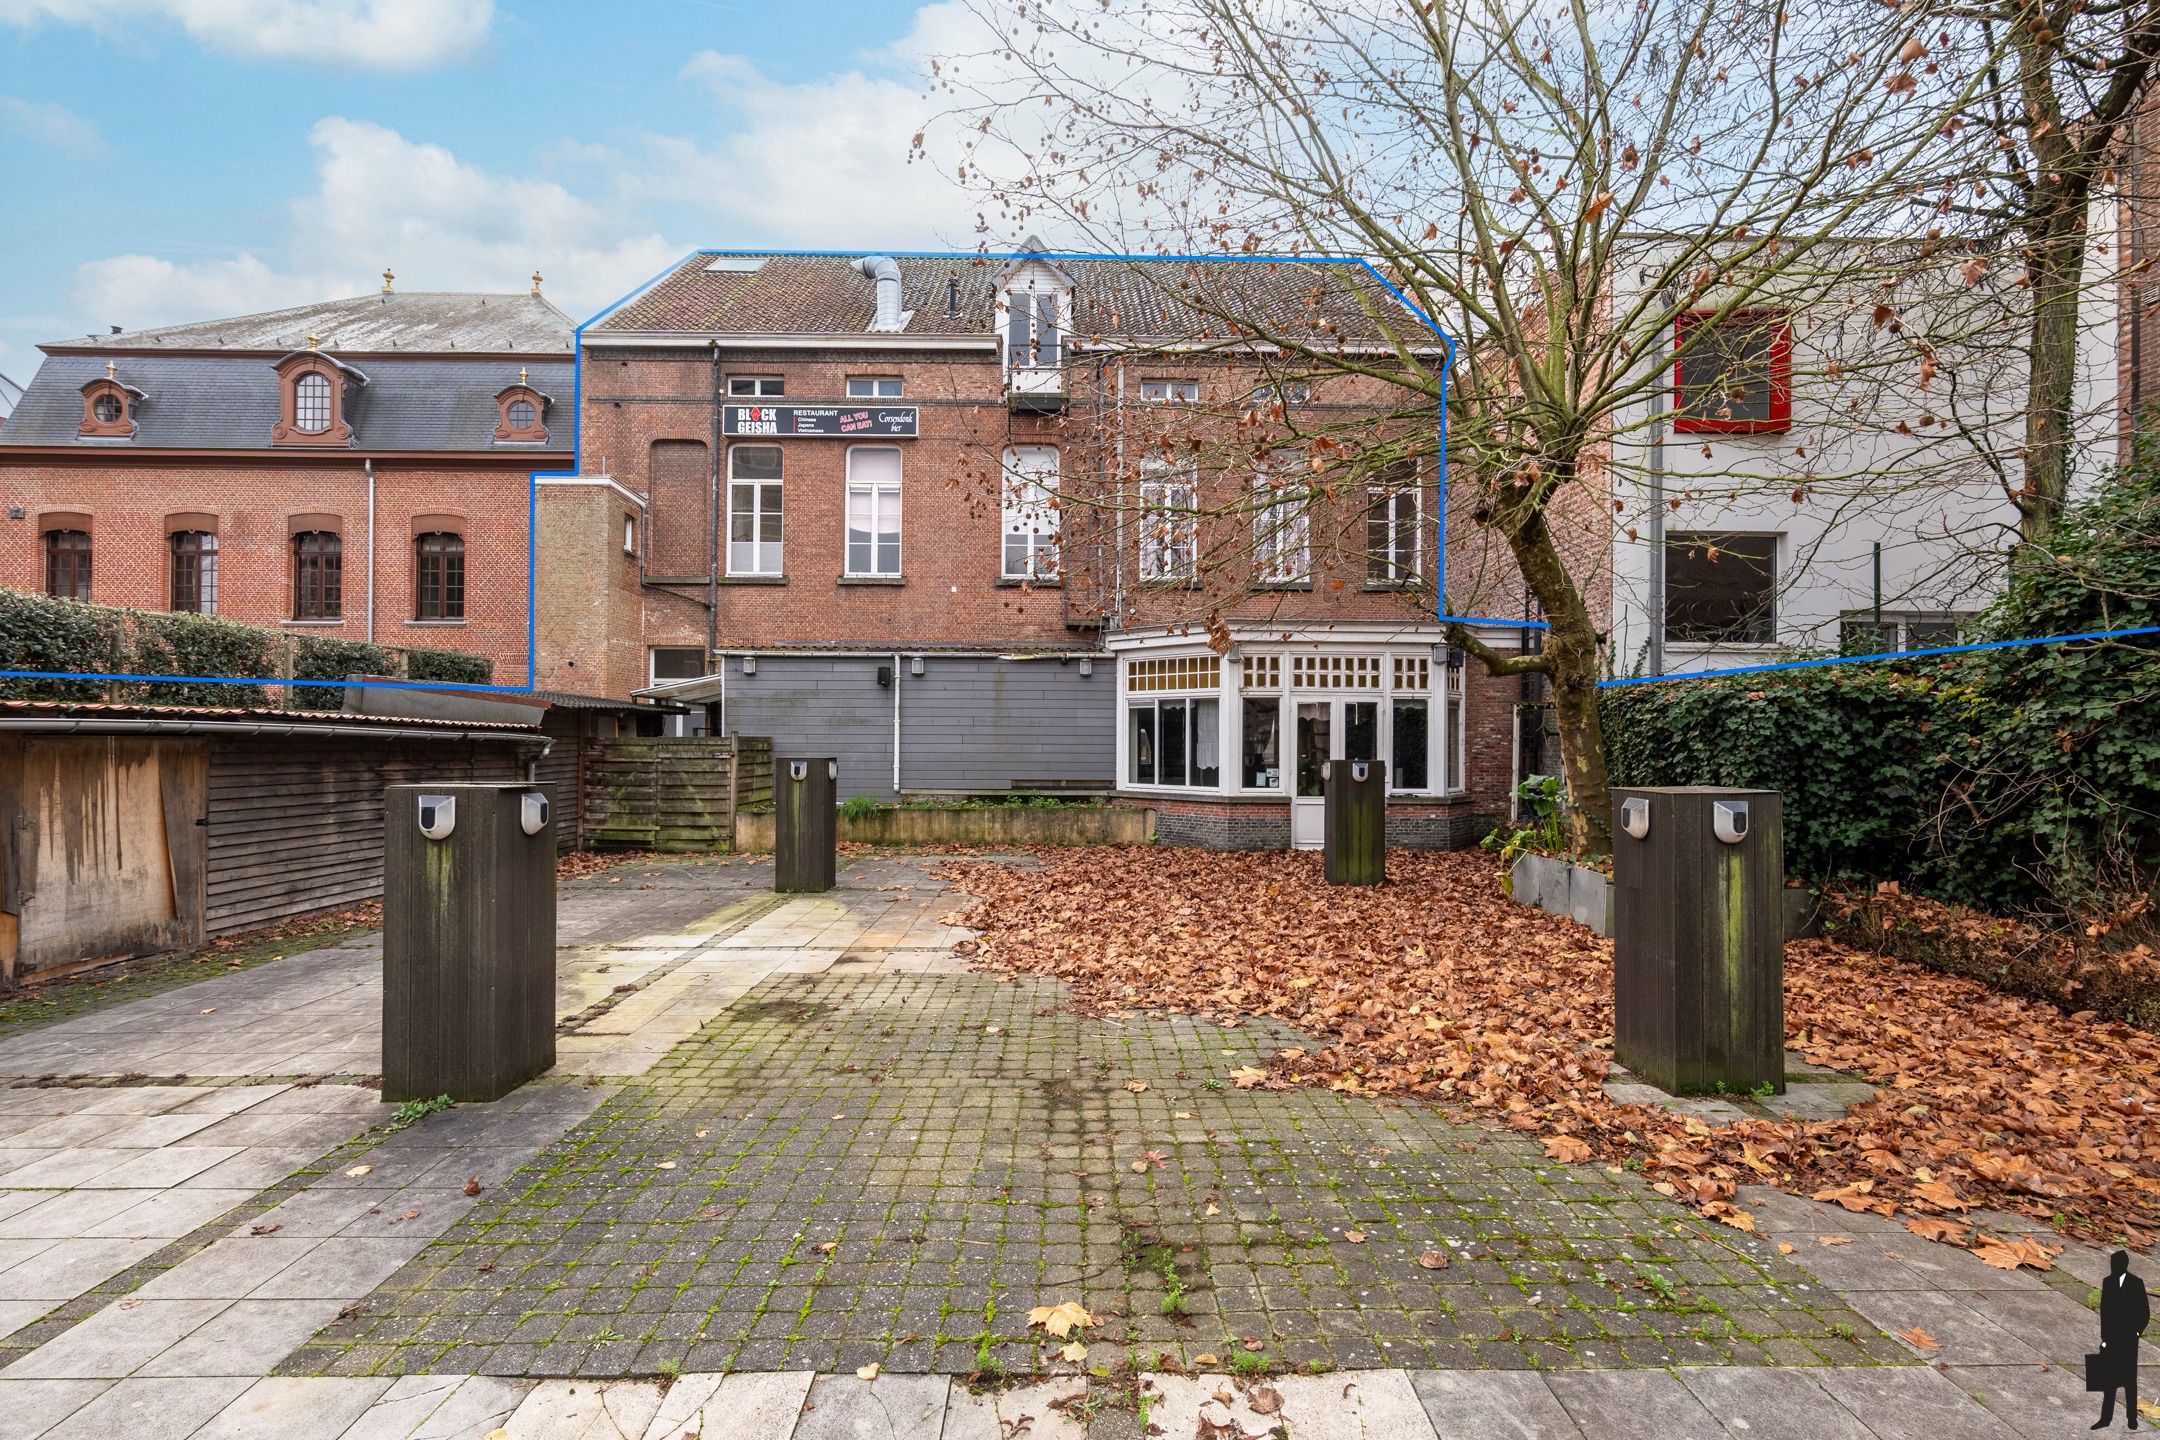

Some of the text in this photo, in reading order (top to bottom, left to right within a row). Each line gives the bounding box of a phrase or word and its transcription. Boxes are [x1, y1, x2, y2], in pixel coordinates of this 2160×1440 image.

[839, 411, 869, 424] ALL YOU
[737, 421, 778, 434] GEISHA
[840, 423, 857, 433] CAN
